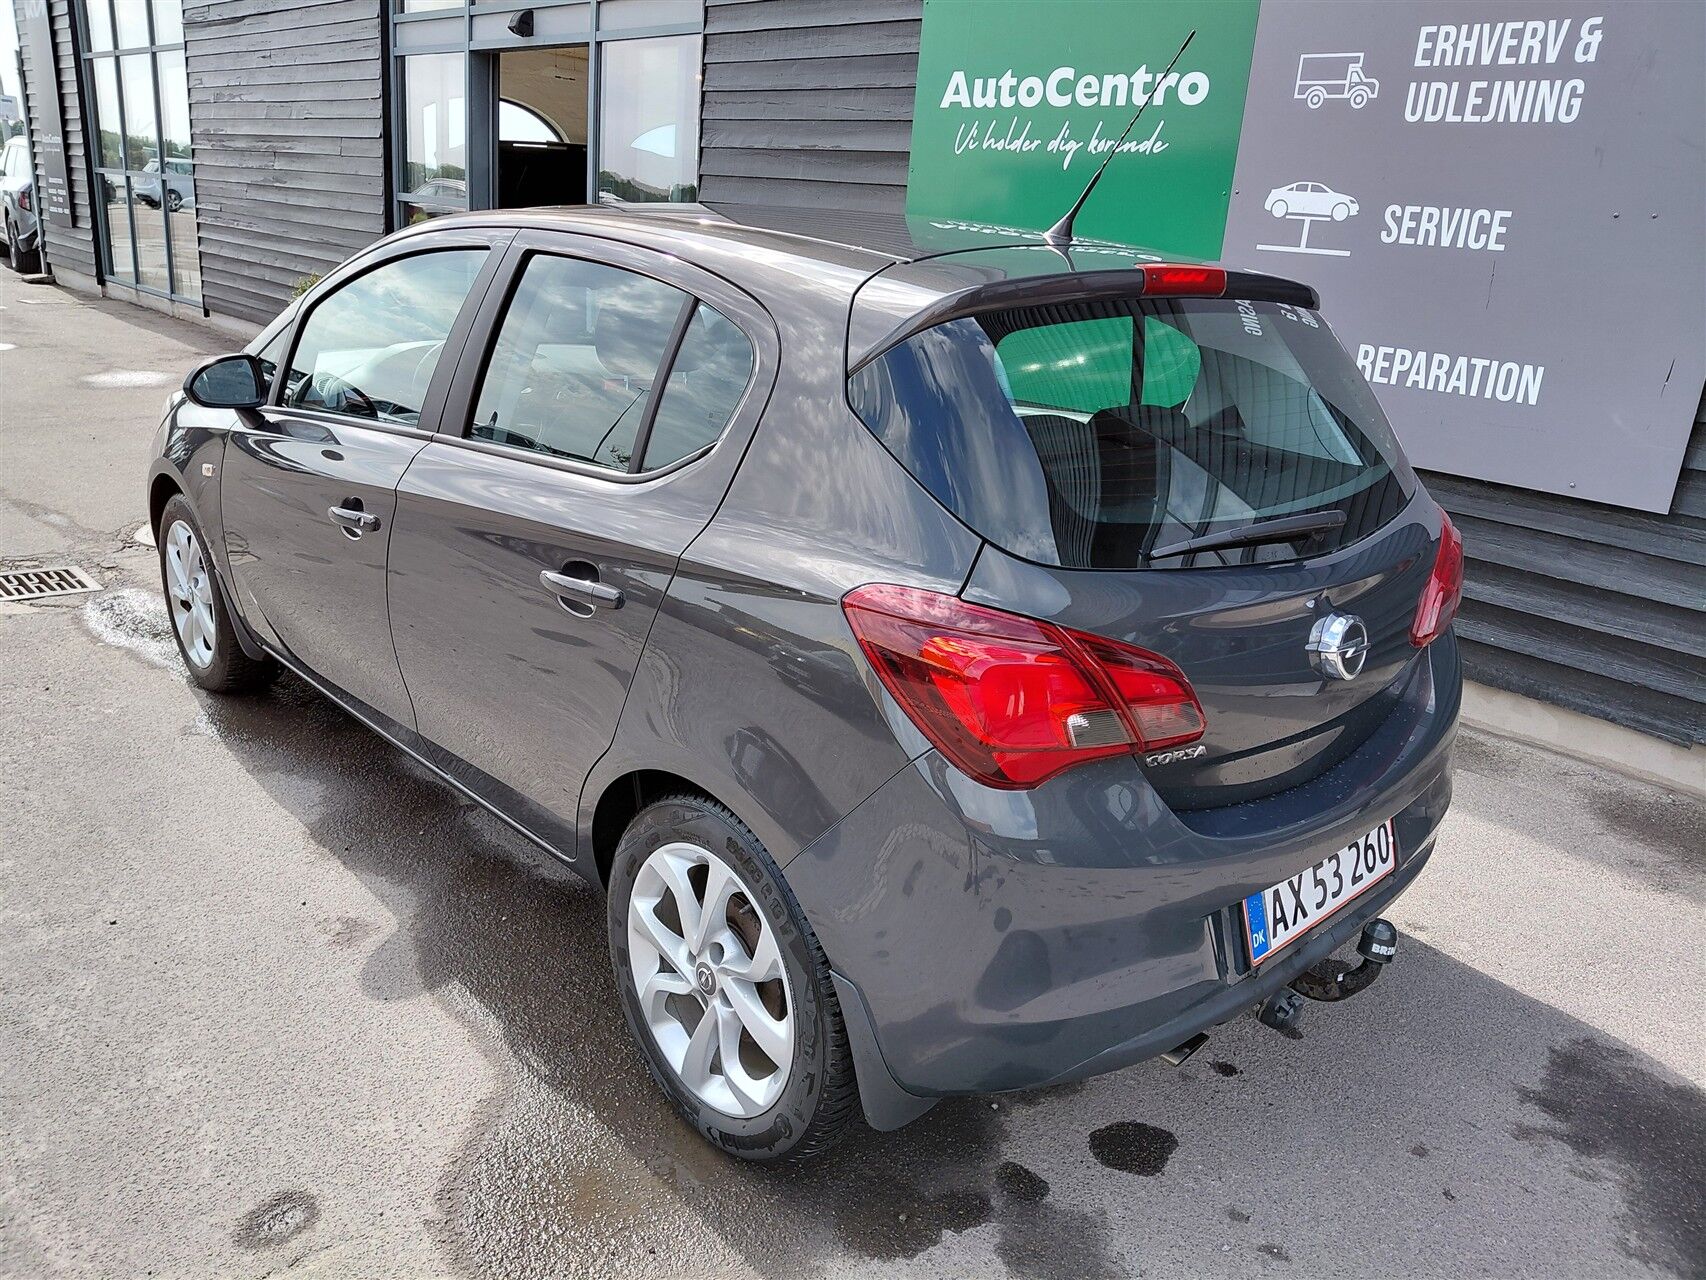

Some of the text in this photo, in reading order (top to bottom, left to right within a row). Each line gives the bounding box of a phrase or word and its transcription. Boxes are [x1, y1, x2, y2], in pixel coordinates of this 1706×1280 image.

[1414, 16, 1603, 67] ERHVERV &
[939, 64, 1210, 108] AutoCentro
[1404, 79, 1585, 123] UDLEJNING
[955, 120, 979, 155] Vi
[982, 116, 1041, 153] holder
[1047, 120, 1083, 170] dig
[1380, 204, 1512, 251] SERVICE
[1356, 344, 1545, 406] REPARATION
[1146, 745, 1207, 767] CORSA
[1272, 822, 1390, 940] AX 53 260
[1252, 928, 1265, 949] DK
